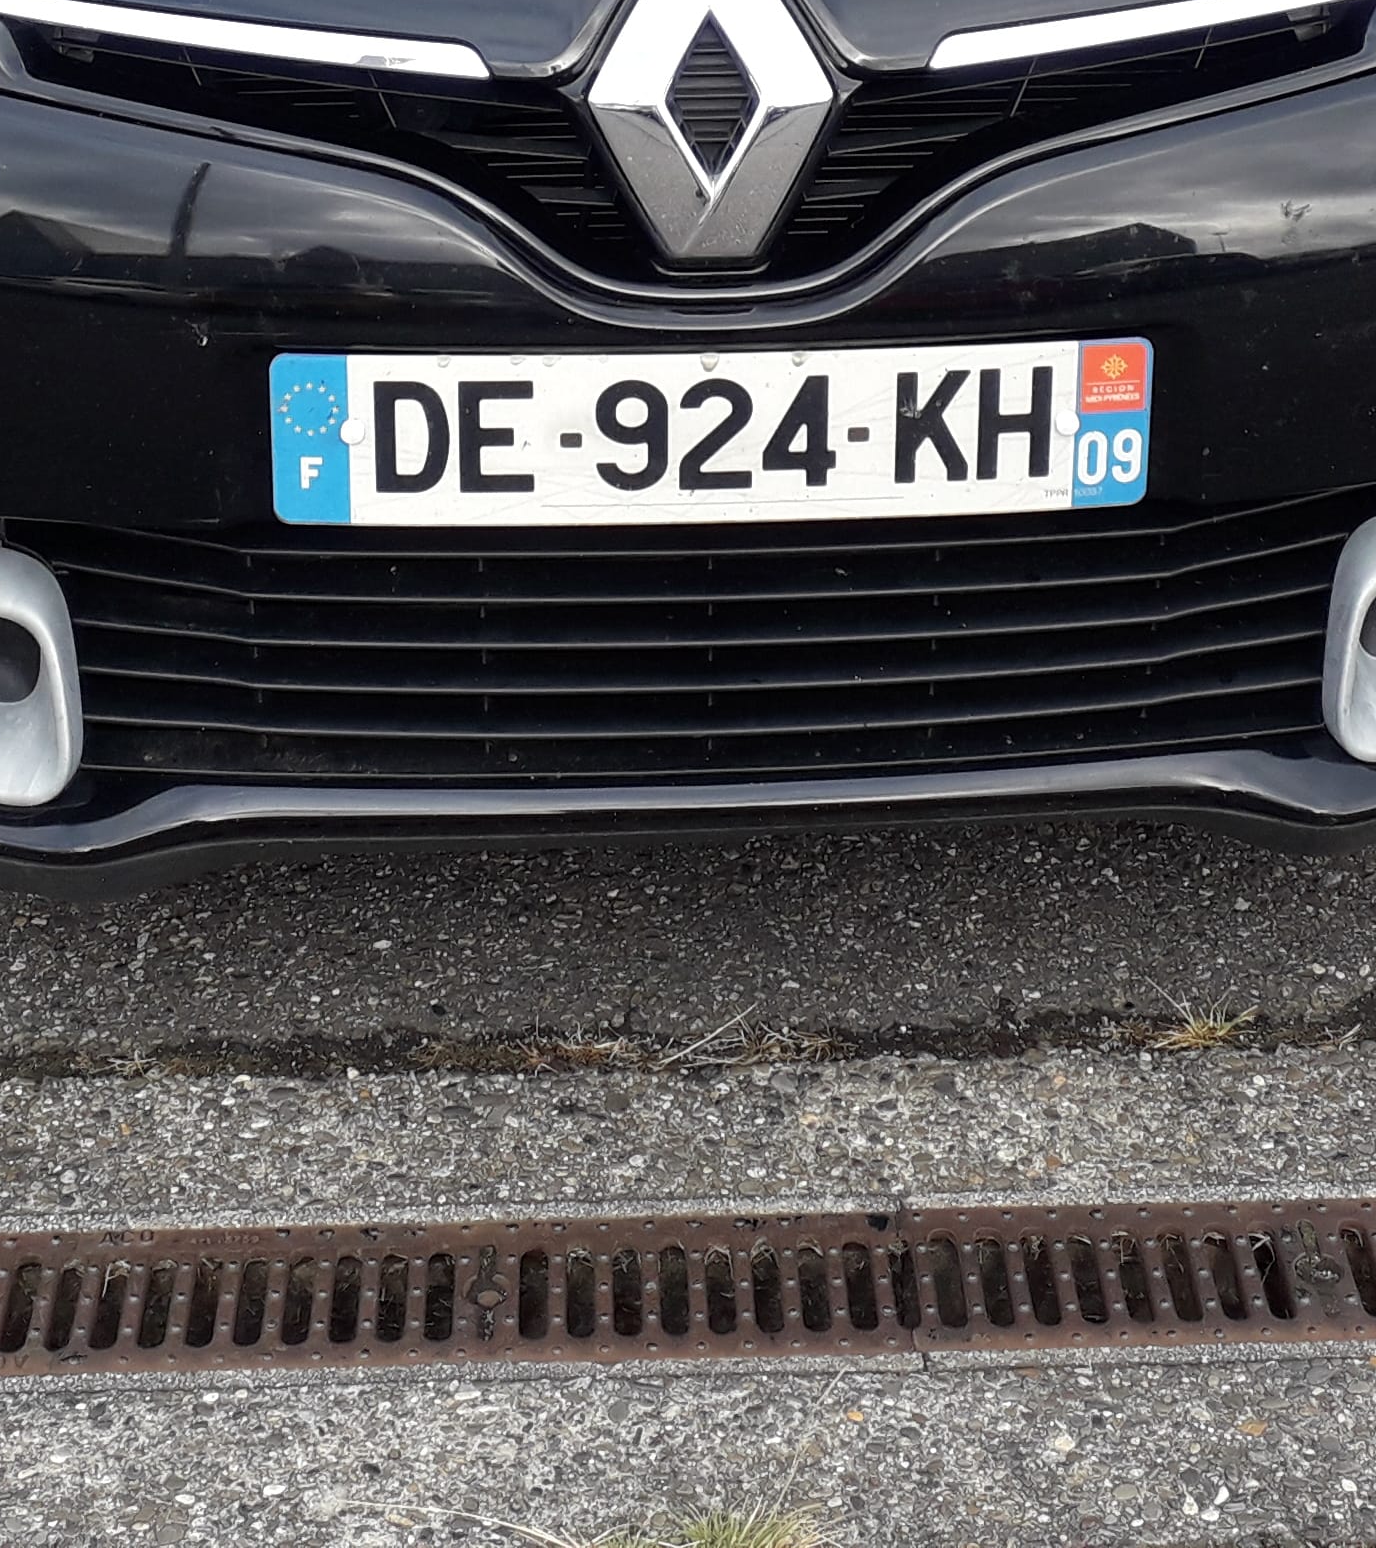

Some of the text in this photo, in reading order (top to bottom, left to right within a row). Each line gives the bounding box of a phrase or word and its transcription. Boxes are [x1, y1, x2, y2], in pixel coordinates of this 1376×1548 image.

[372, 365, 1054, 494] DE-924-KH
[1077, 428, 1143, 486] 09
[299, 456, 324, 490] F
